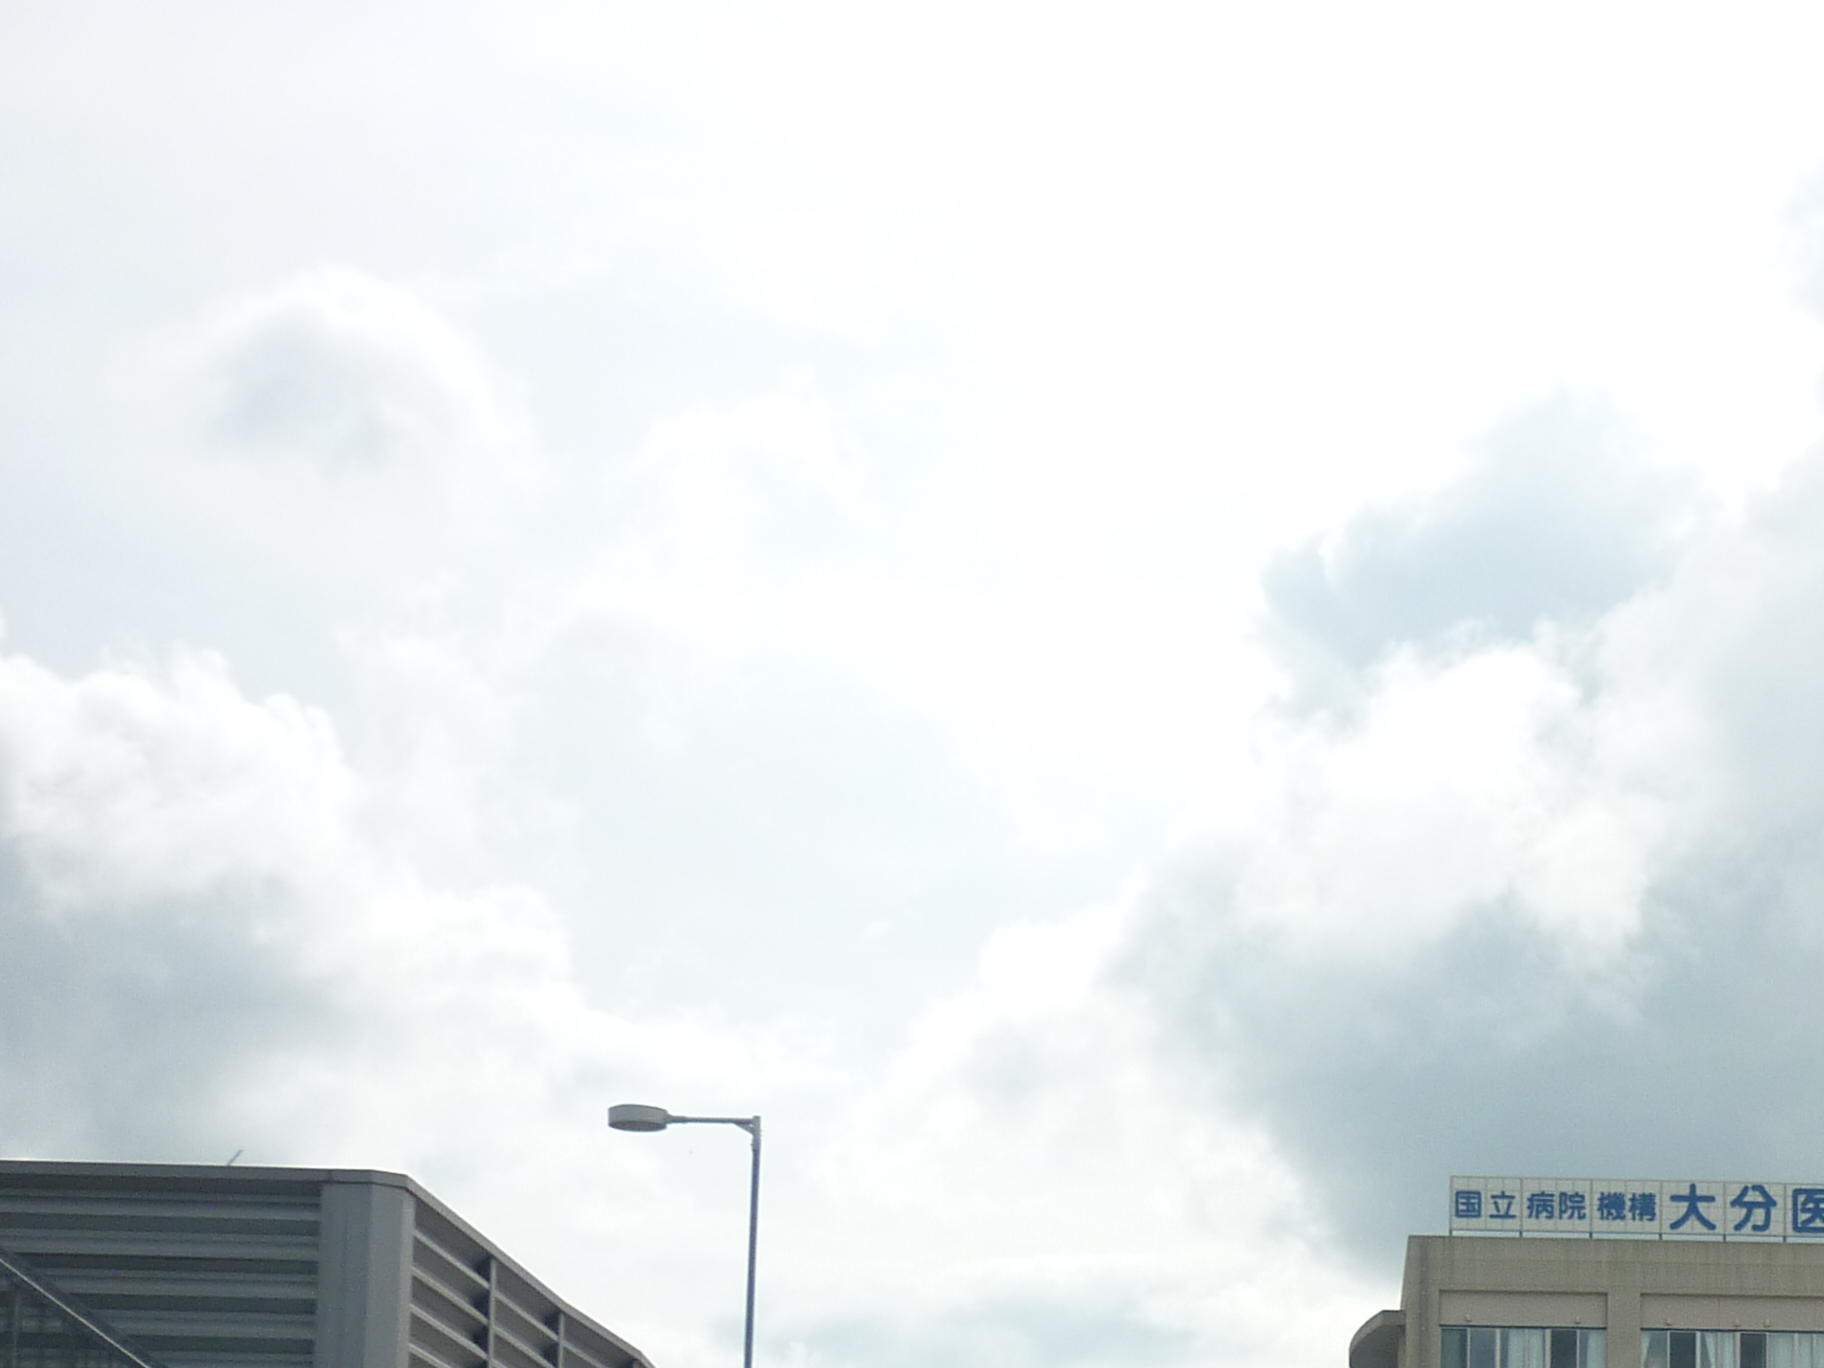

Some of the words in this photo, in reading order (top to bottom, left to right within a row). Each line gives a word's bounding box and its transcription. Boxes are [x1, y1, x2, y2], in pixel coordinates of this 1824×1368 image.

[1453, 1190, 1658, 1222] 国立病院機構
